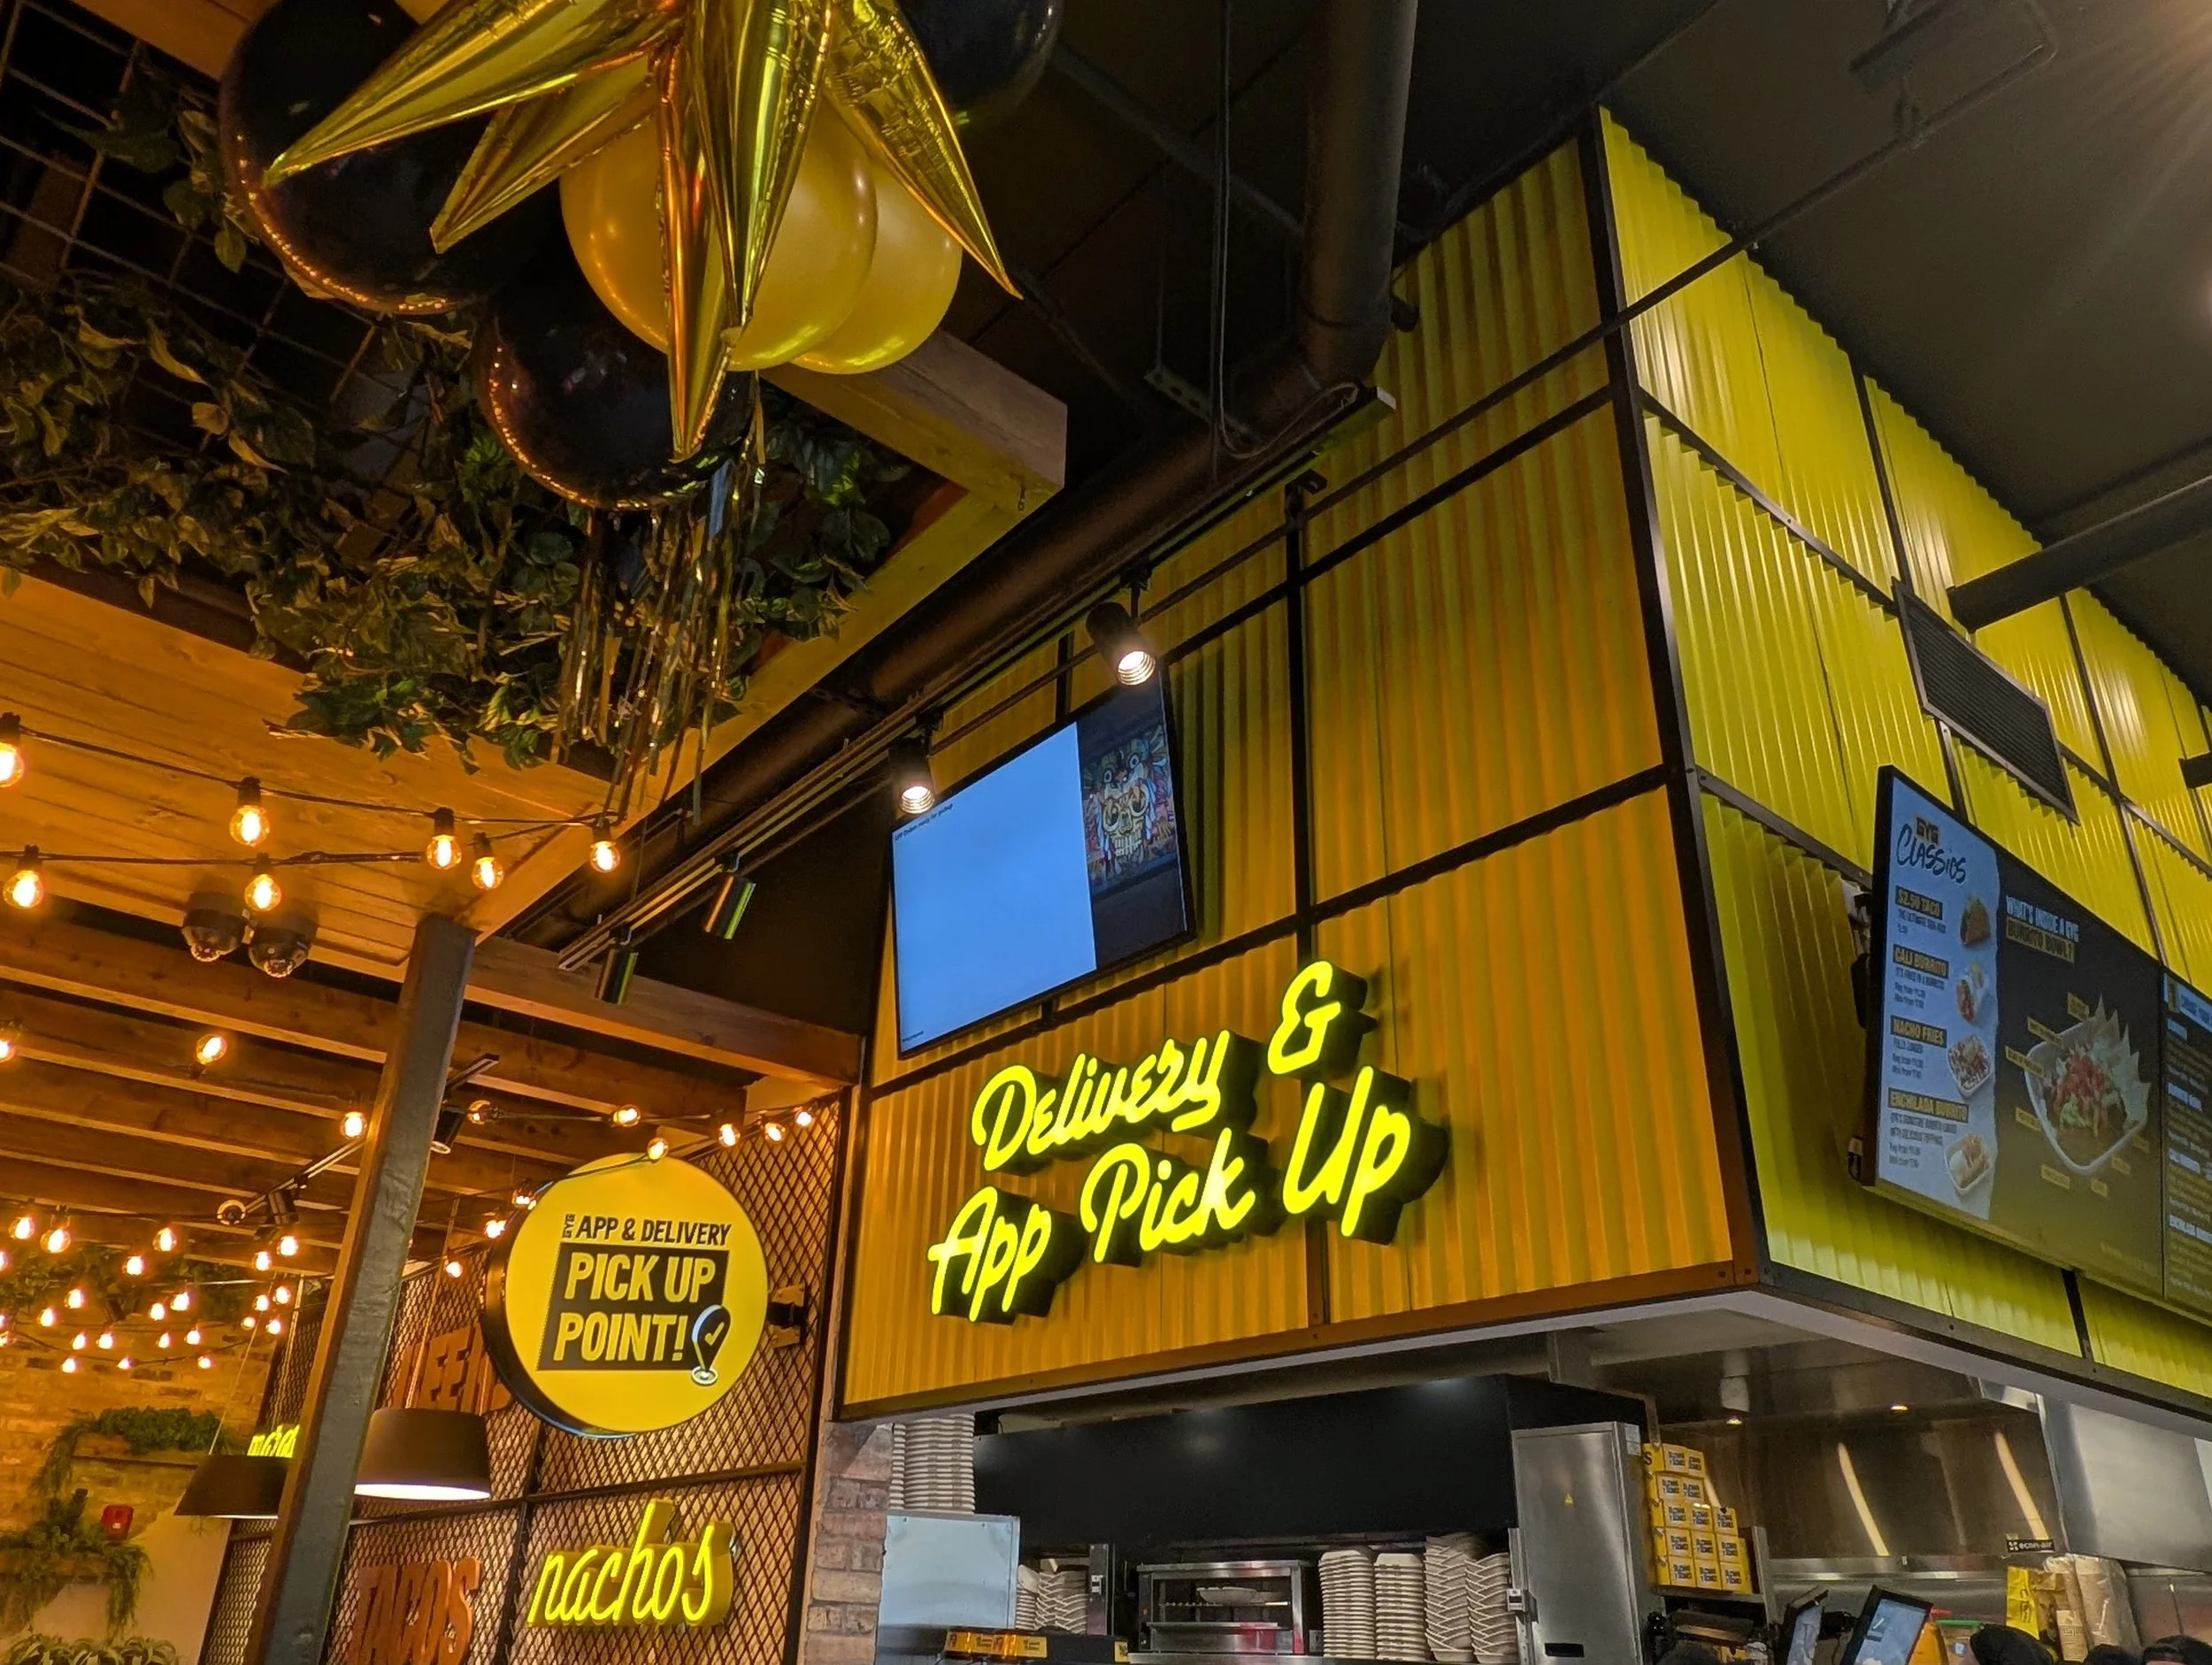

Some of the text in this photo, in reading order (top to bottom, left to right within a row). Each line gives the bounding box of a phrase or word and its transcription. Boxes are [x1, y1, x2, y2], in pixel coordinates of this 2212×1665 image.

[1916, 817, 1939, 846] GYG
[2006, 894, 2033, 925] WHAT'S
[1915, 955, 1947, 976] BURRITO
[1893, 1017, 1921, 1039] NACHO
[1922, 1026, 1944, 1046] FRIES
[971, 960, 1341, 1172] Delivery &
[1890, 1091, 1934, 1115] ENCHILADA
[926, 1065, 1411, 1323] App Pick Up
[561, 1213, 575, 1239] GYG
[575, 1216, 733, 1247] APP & DELIVERY
[564, 1252, 716, 1303] PICK UP
[553, 1311, 688, 1362] POINT!
[527, 1500, 717, 1627] nachos
